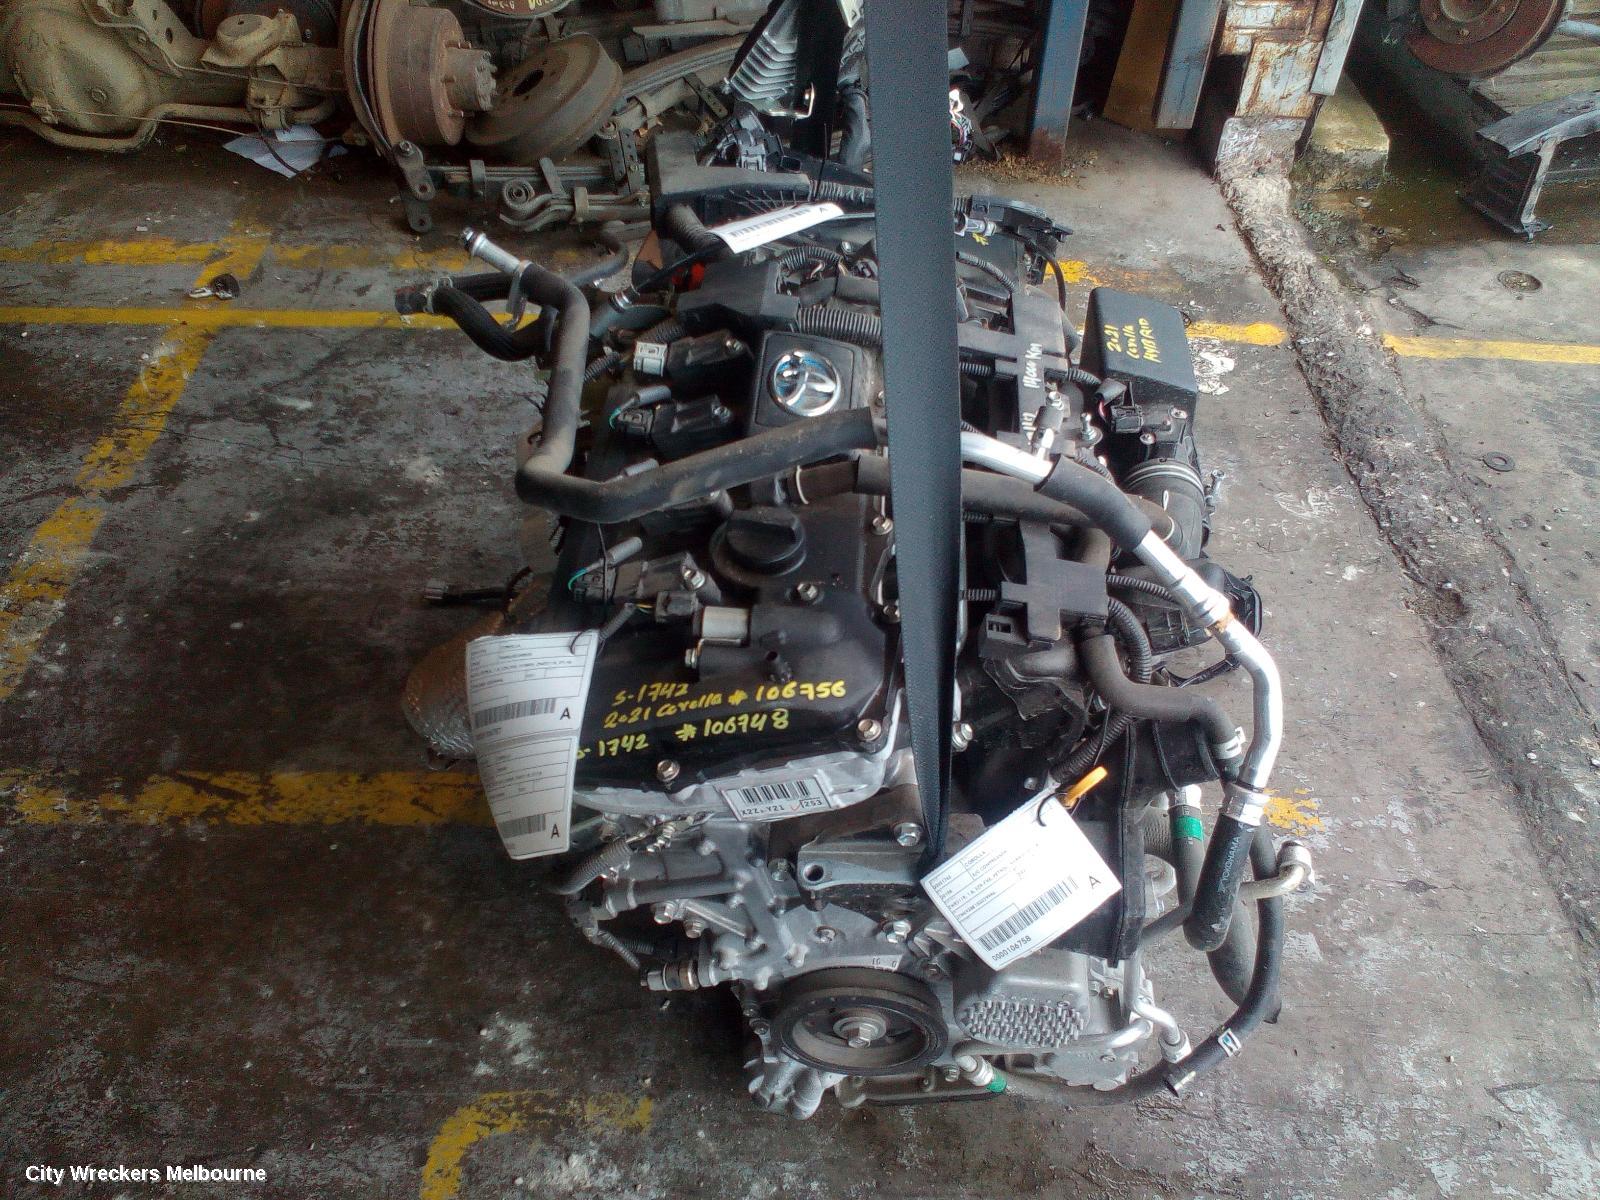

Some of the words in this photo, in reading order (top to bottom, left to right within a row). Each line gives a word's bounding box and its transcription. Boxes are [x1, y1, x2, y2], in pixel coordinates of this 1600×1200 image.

[755, 680, 847, 701] 106756
[560, 707, 571, 720] A
[703, 708, 789, 737] 106748
[551, 823, 560, 839] A
[1088, 874, 1102, 889] A
[991, 934, 1032, 962] 0000106758
